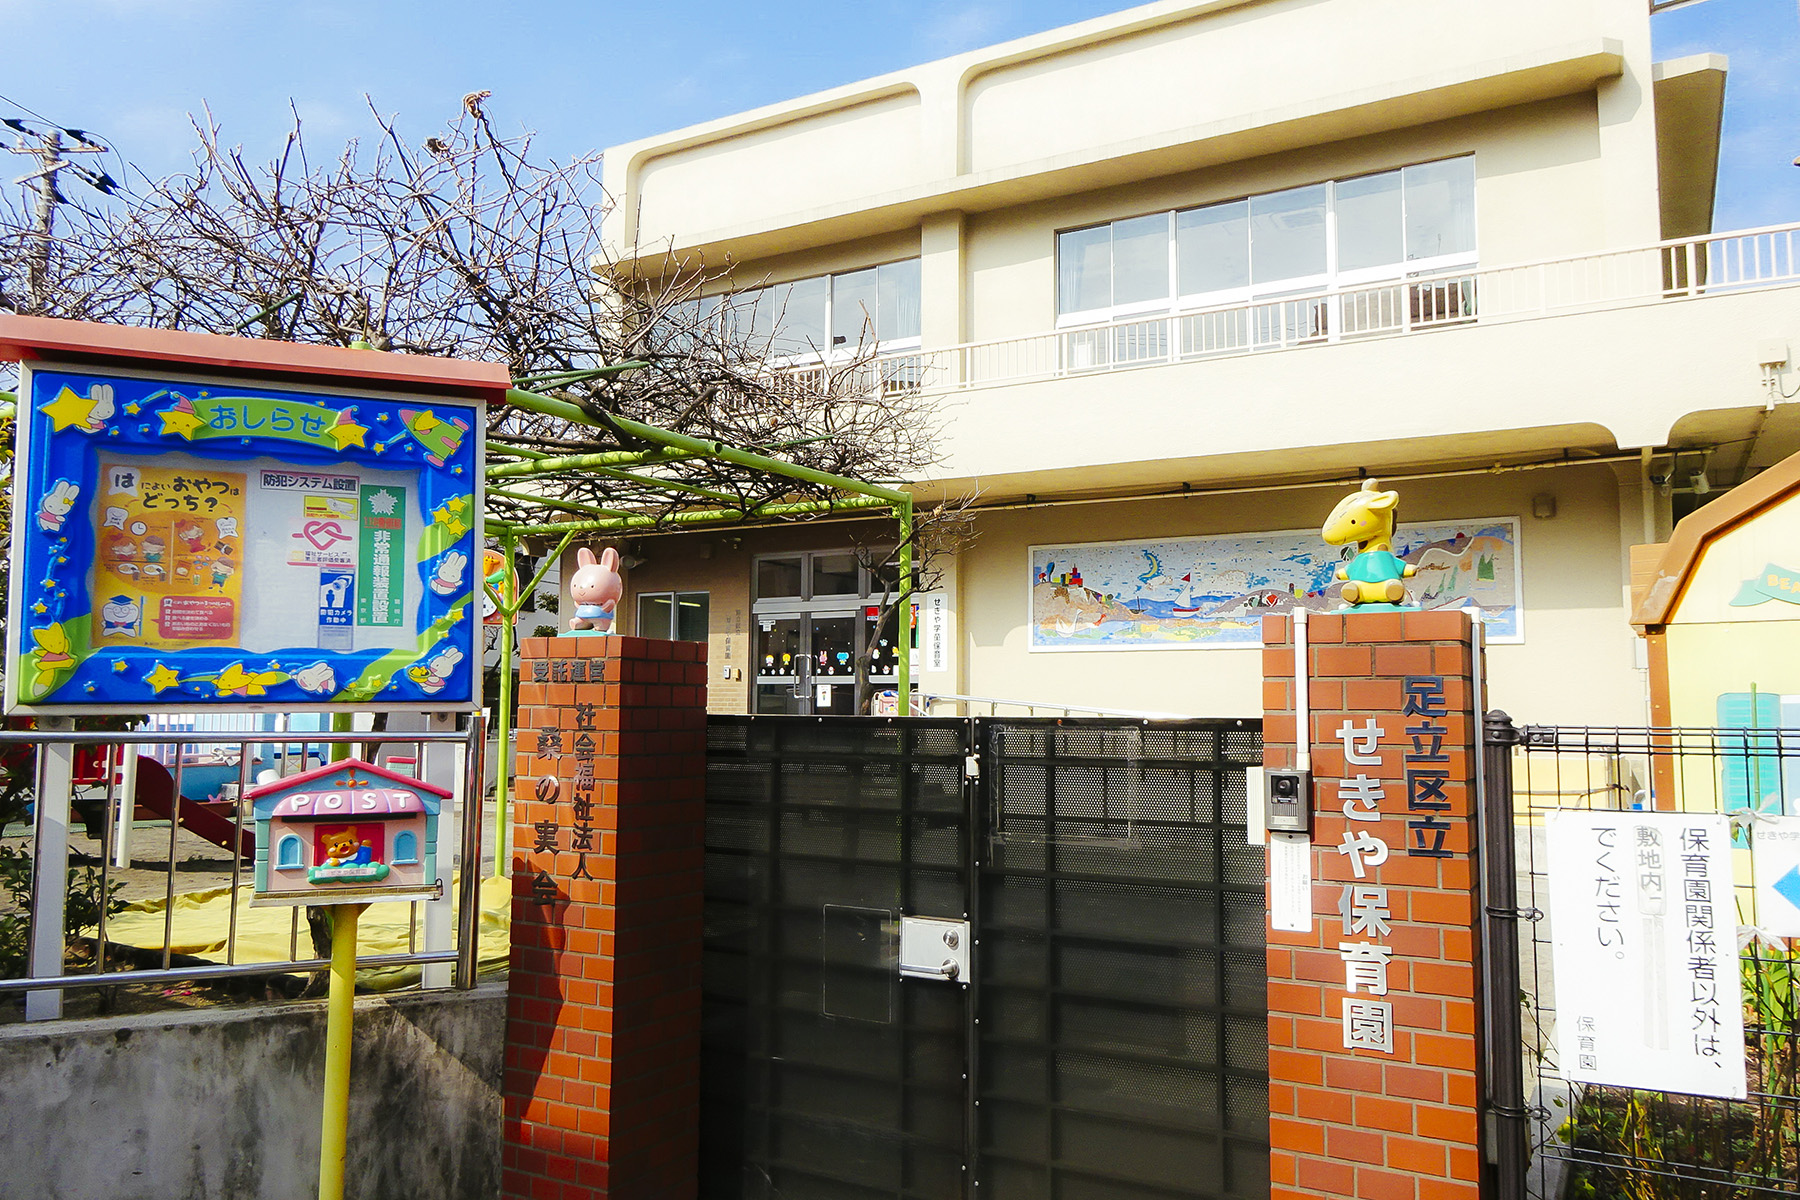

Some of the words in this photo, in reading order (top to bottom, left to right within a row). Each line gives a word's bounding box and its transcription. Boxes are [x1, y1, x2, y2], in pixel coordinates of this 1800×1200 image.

[209, 404, 327, 438] おしらせ
[143, 493, 218, 512] どっち？
[263, 474, 356, 491] 防犯システム設置
[372, 530, 391, 624] 非常通報装置設置
[1767, 574, 1800, 593] BEA
[532, 660, 605, 683] 受託運営
[290, 792, 412, 812] POST
[571, 702, 597, 882] 社会福祉法人
[1401, 675, 1453, 859] 足立区立
[531, 726, 563, 906] 桑の実会
[1335, 718, 1394, 1055] せきや保育園
[1591, 827, 1625, 960] でください。
[1679, 826, 1722, 1069] 保育園関係者以外は、
[1576, 1015, 1597, 1071] 保育園
